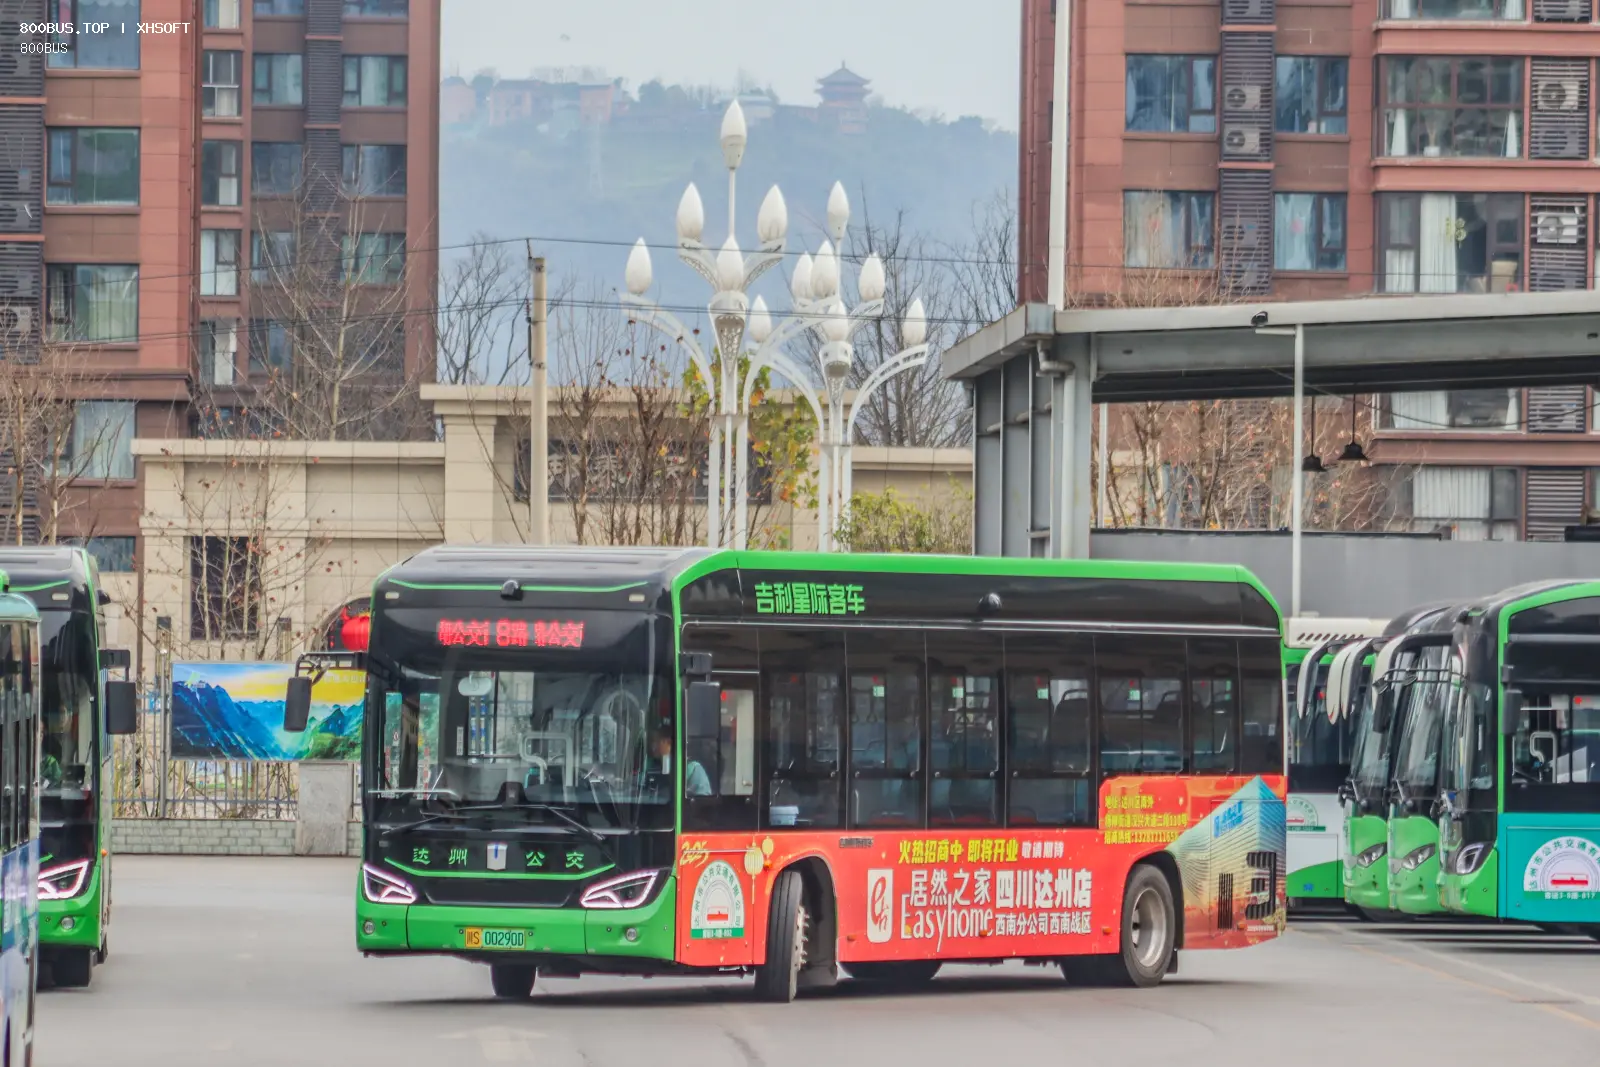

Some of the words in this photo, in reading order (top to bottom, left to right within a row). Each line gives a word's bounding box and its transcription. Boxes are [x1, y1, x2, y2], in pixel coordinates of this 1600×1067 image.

[754, 582, 865, 615] 吉利星际客车
[898, 840, 964, 864] 火热招商中
[967, 838, 1019, 863] 即将开业
[1021, 840, 1065, 859] 敬请期待
[909, 868, 992, 907] 居然之家
[995, 869, 1092, 909] 四川达州店
[900, 893, 994, 953] Easyhome
